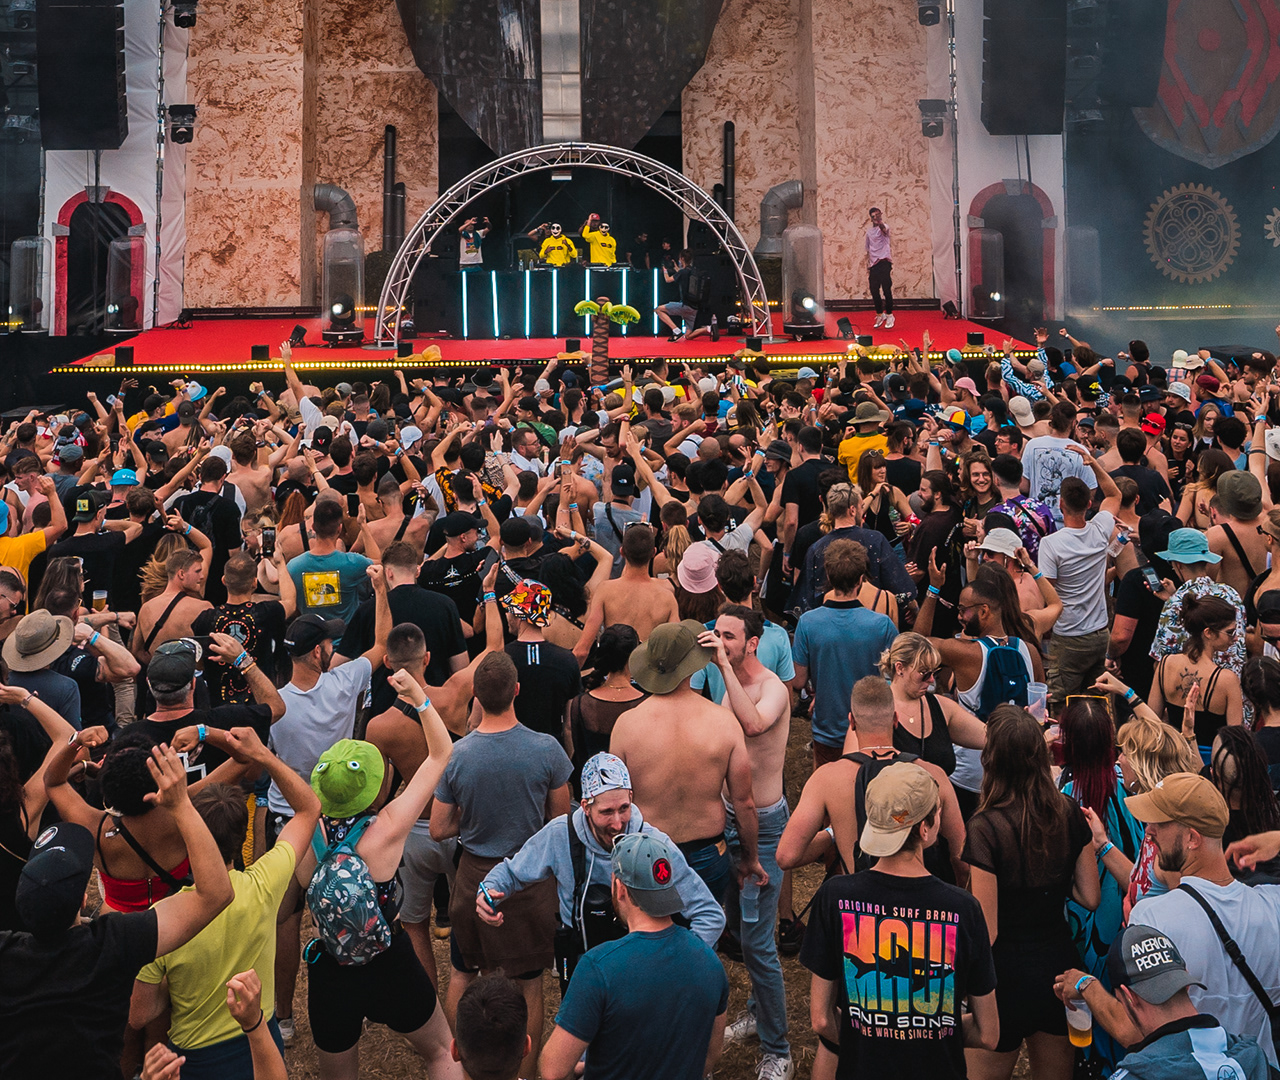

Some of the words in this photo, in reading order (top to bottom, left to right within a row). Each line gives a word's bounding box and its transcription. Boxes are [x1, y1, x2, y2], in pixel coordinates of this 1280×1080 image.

[838, 899, 887, 916] ORIGINAL
[893, 906, 920, 919] SURF
[926, 909, 960, 923] BRAND
[1135, 950, 1173, 972] PEOPLE
[848, 1005, 888, 1026] AND
[875, 1027, 906, 1040] WATER
[908, 1028, 933, 1040] SINCE
